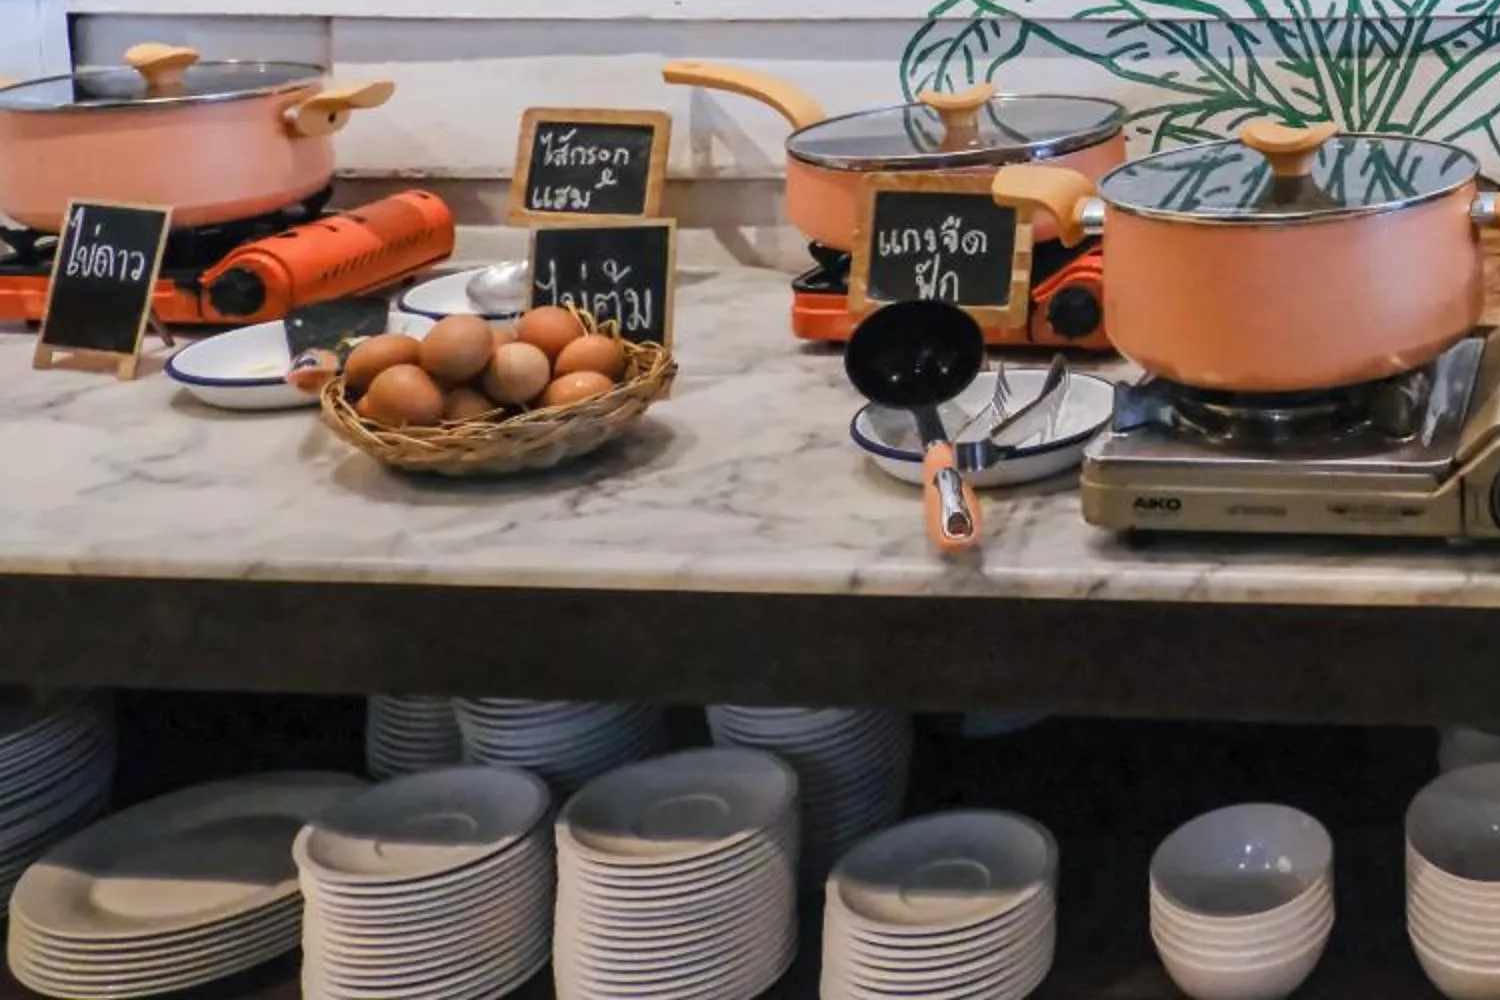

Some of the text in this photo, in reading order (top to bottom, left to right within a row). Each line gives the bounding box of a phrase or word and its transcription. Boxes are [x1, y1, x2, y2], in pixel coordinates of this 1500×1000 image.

[66, 206, 145, 281] ไข่ดาว
[1132, 497, 1182, 512] AIKO
